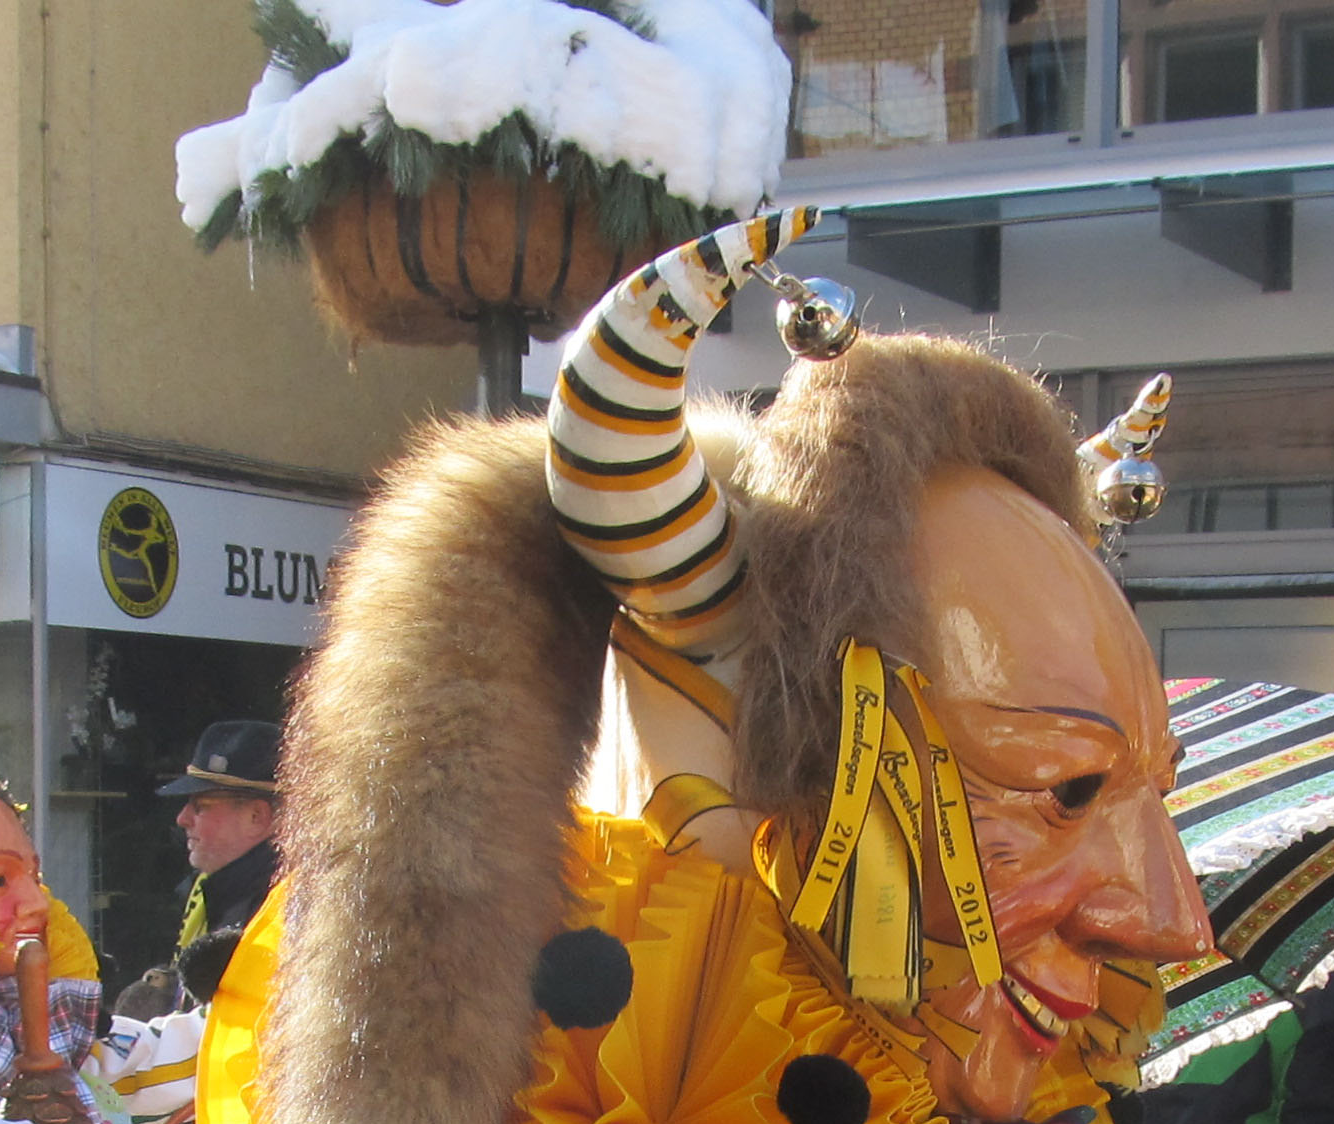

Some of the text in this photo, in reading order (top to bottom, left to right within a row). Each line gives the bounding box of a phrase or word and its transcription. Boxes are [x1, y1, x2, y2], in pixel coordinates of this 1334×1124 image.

[815, 684, 880, 884] Brezelsegen 2011
[955, 881, 989, 946] 2012
